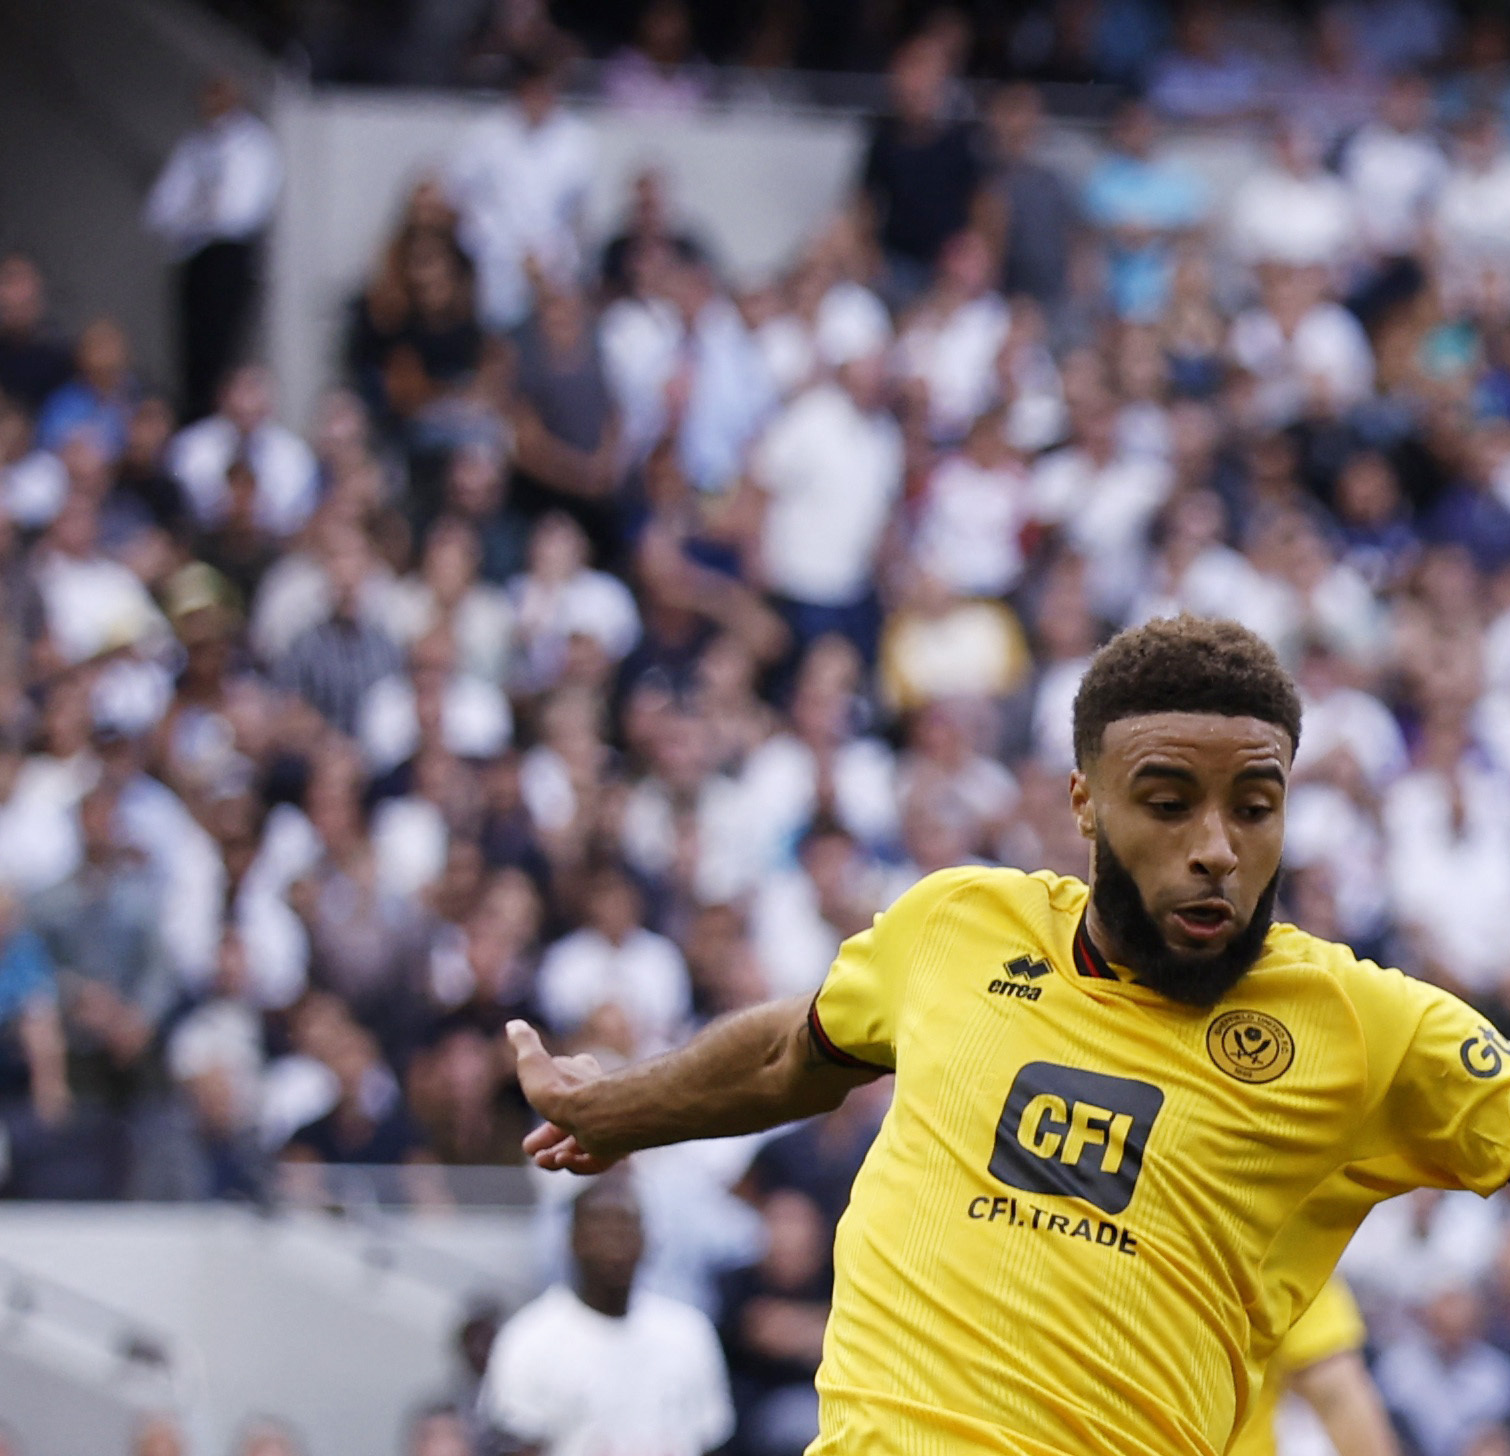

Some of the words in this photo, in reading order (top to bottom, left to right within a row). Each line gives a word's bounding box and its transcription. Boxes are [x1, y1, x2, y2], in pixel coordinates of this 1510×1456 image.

[988, 979, 1042, 1002] errea
[1017, 1093, 1134, 1174] CFI
[968, 1196, 1139, 1256] CFI.TRADE
